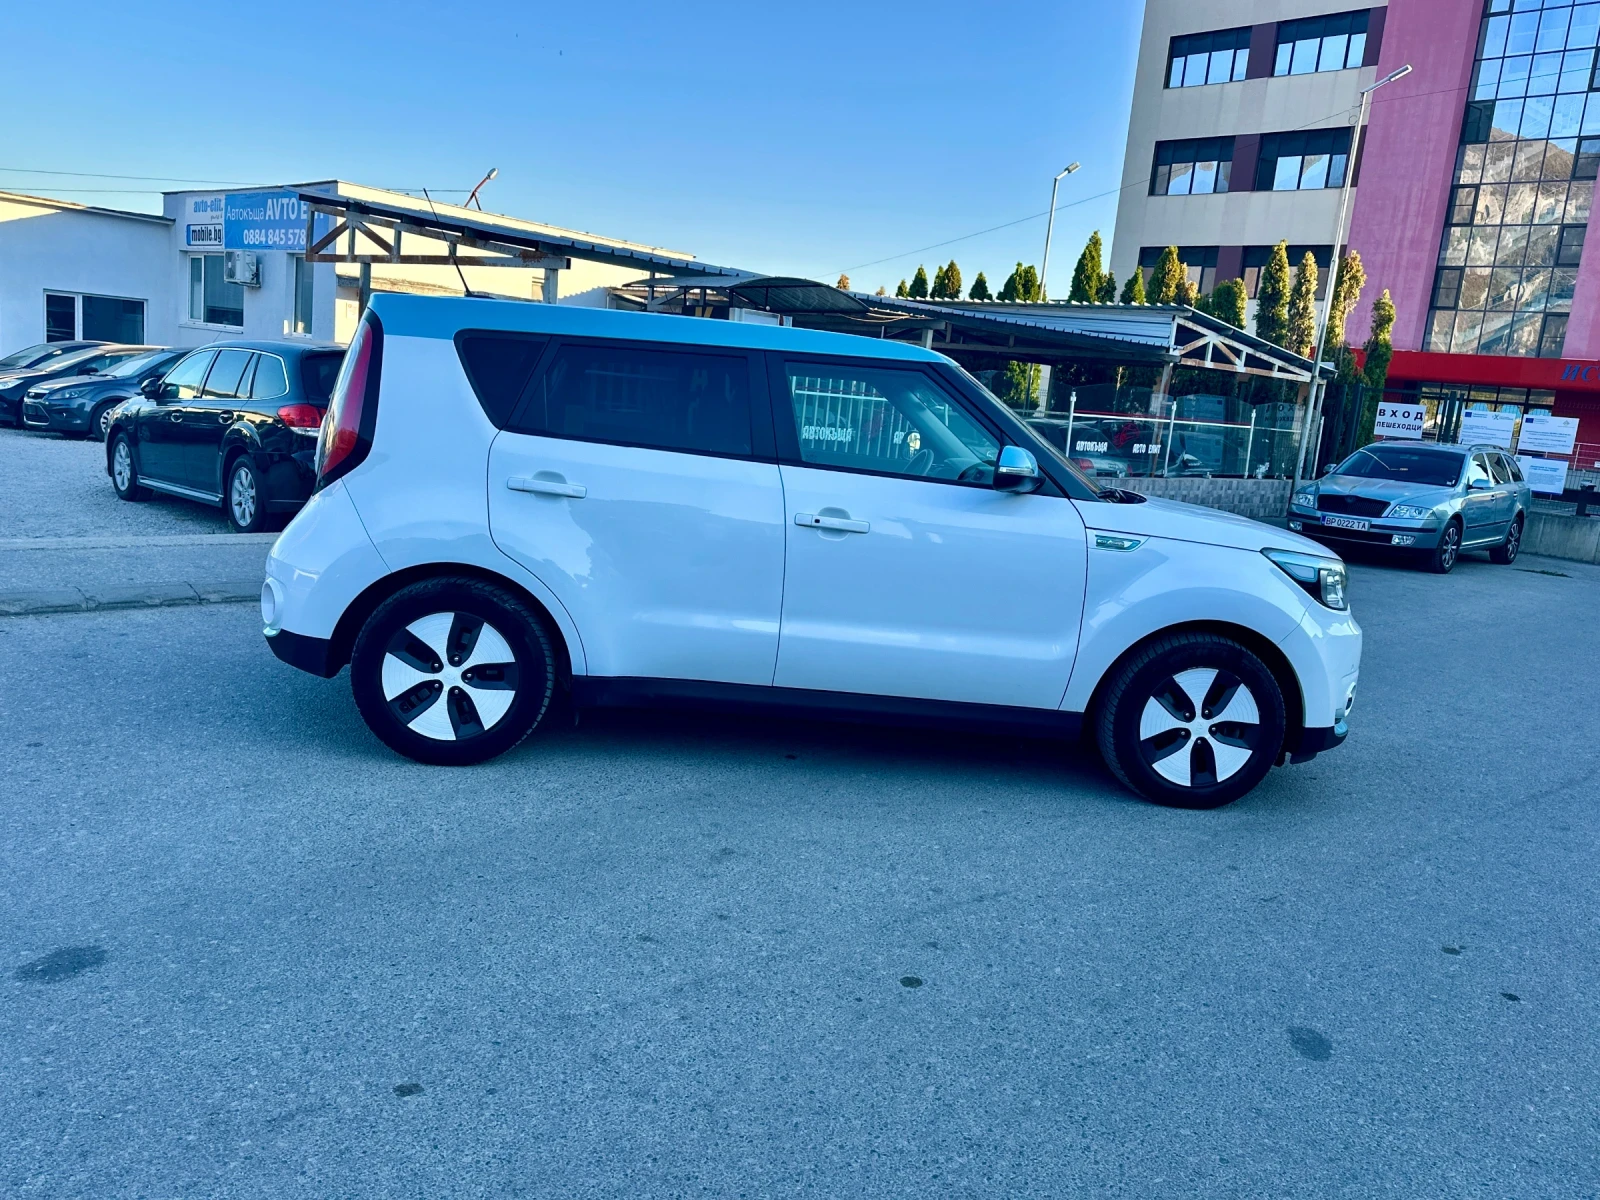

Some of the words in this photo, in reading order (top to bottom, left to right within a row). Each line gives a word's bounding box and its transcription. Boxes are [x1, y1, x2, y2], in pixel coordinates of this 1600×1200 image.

[226, 206, 264, 222] Автокъща
[265, 198, 298, 220] AVTO
[191, 225, 222, 243] mobile.bg
[243, 229, 266, 245] 0884
[267, 229, 286, 245] 845
[287, 229, 306, 245] 578
[1560, 364, 1600, 382] ИС
[1379, 408, 1424, 421] ВХОД
[1376, 421, 1422, 431] ПЕШЕХОДЦИ
[1336, 518, 1355, 528] 0222
